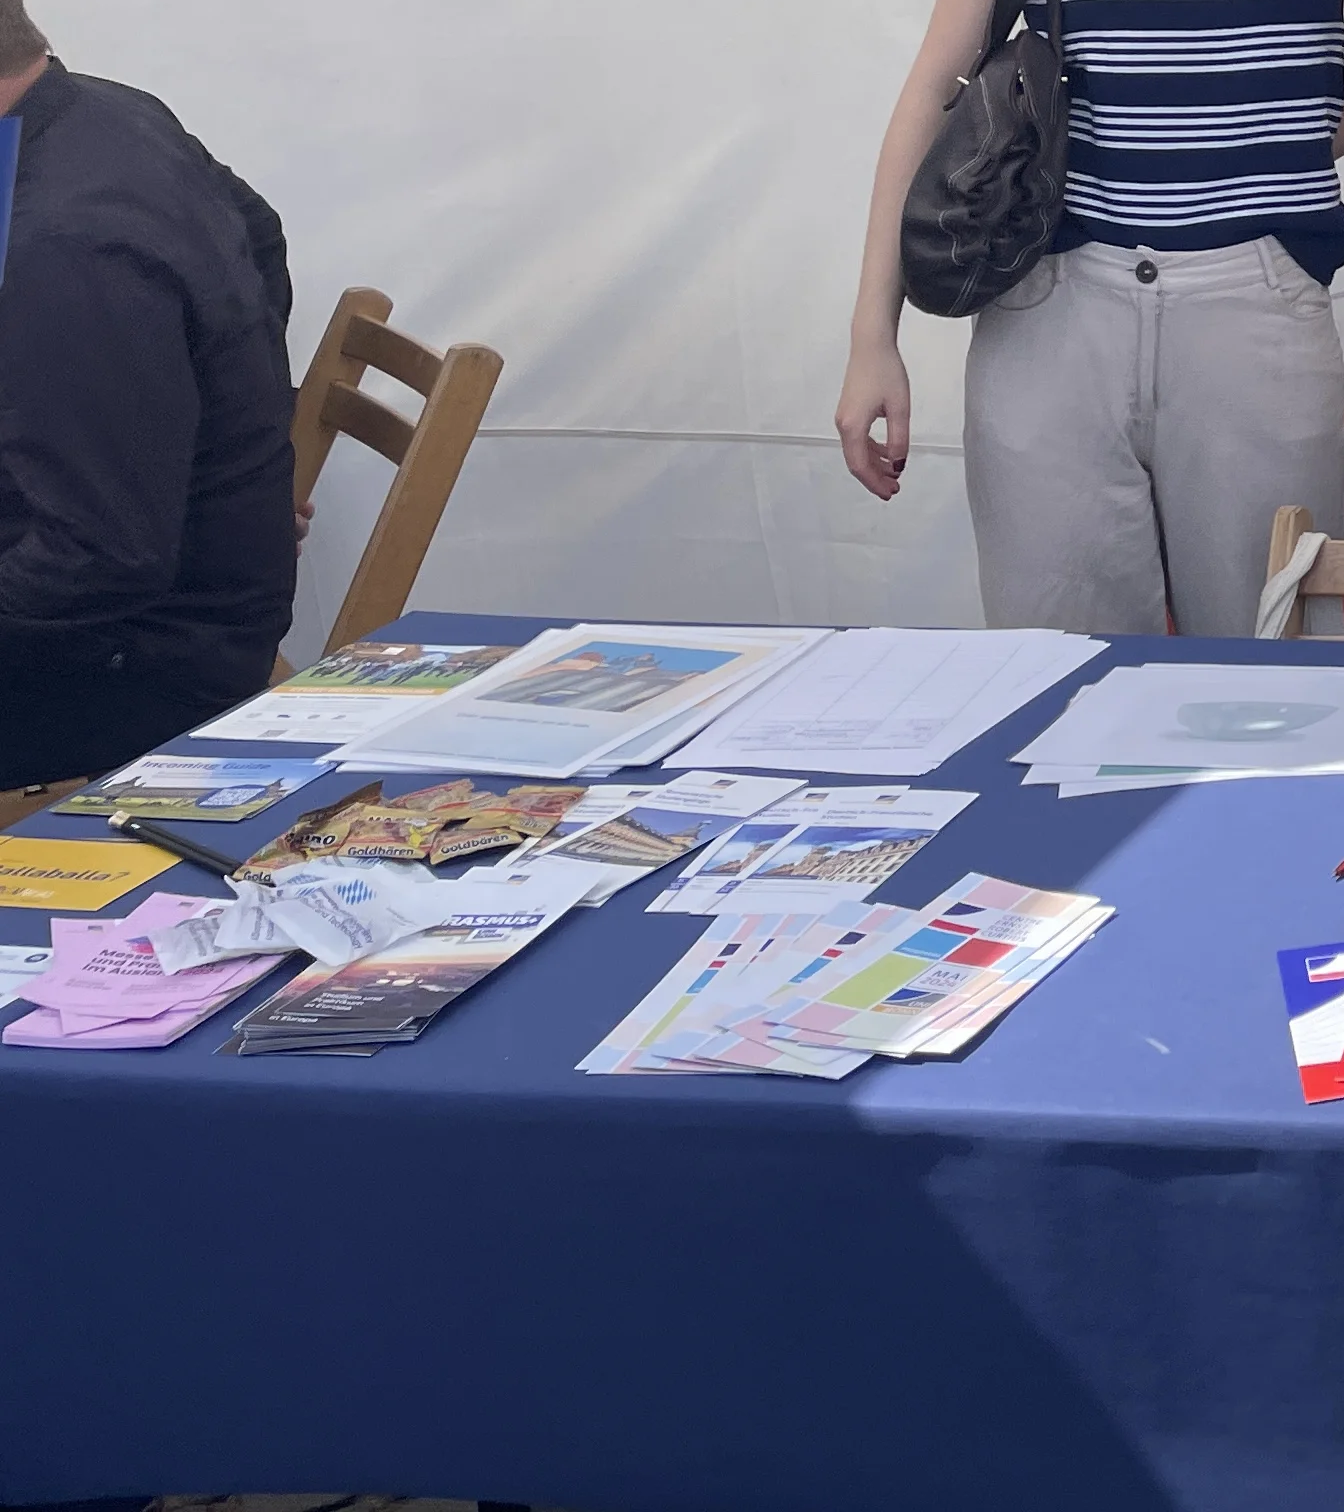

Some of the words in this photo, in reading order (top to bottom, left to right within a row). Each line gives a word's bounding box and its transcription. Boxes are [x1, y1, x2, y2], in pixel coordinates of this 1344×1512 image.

[141, 760, 221, 771] Incoming
[222, 761, 272, 770] Guide
[440, 832, 510, 856] Goldbären
[347, 845, 415, 857] Goldbären
[444, 913, 543, 927] RASMUS+
[932, 969, 969, 982] MAI
[918, 976, 958, 988] 2024
